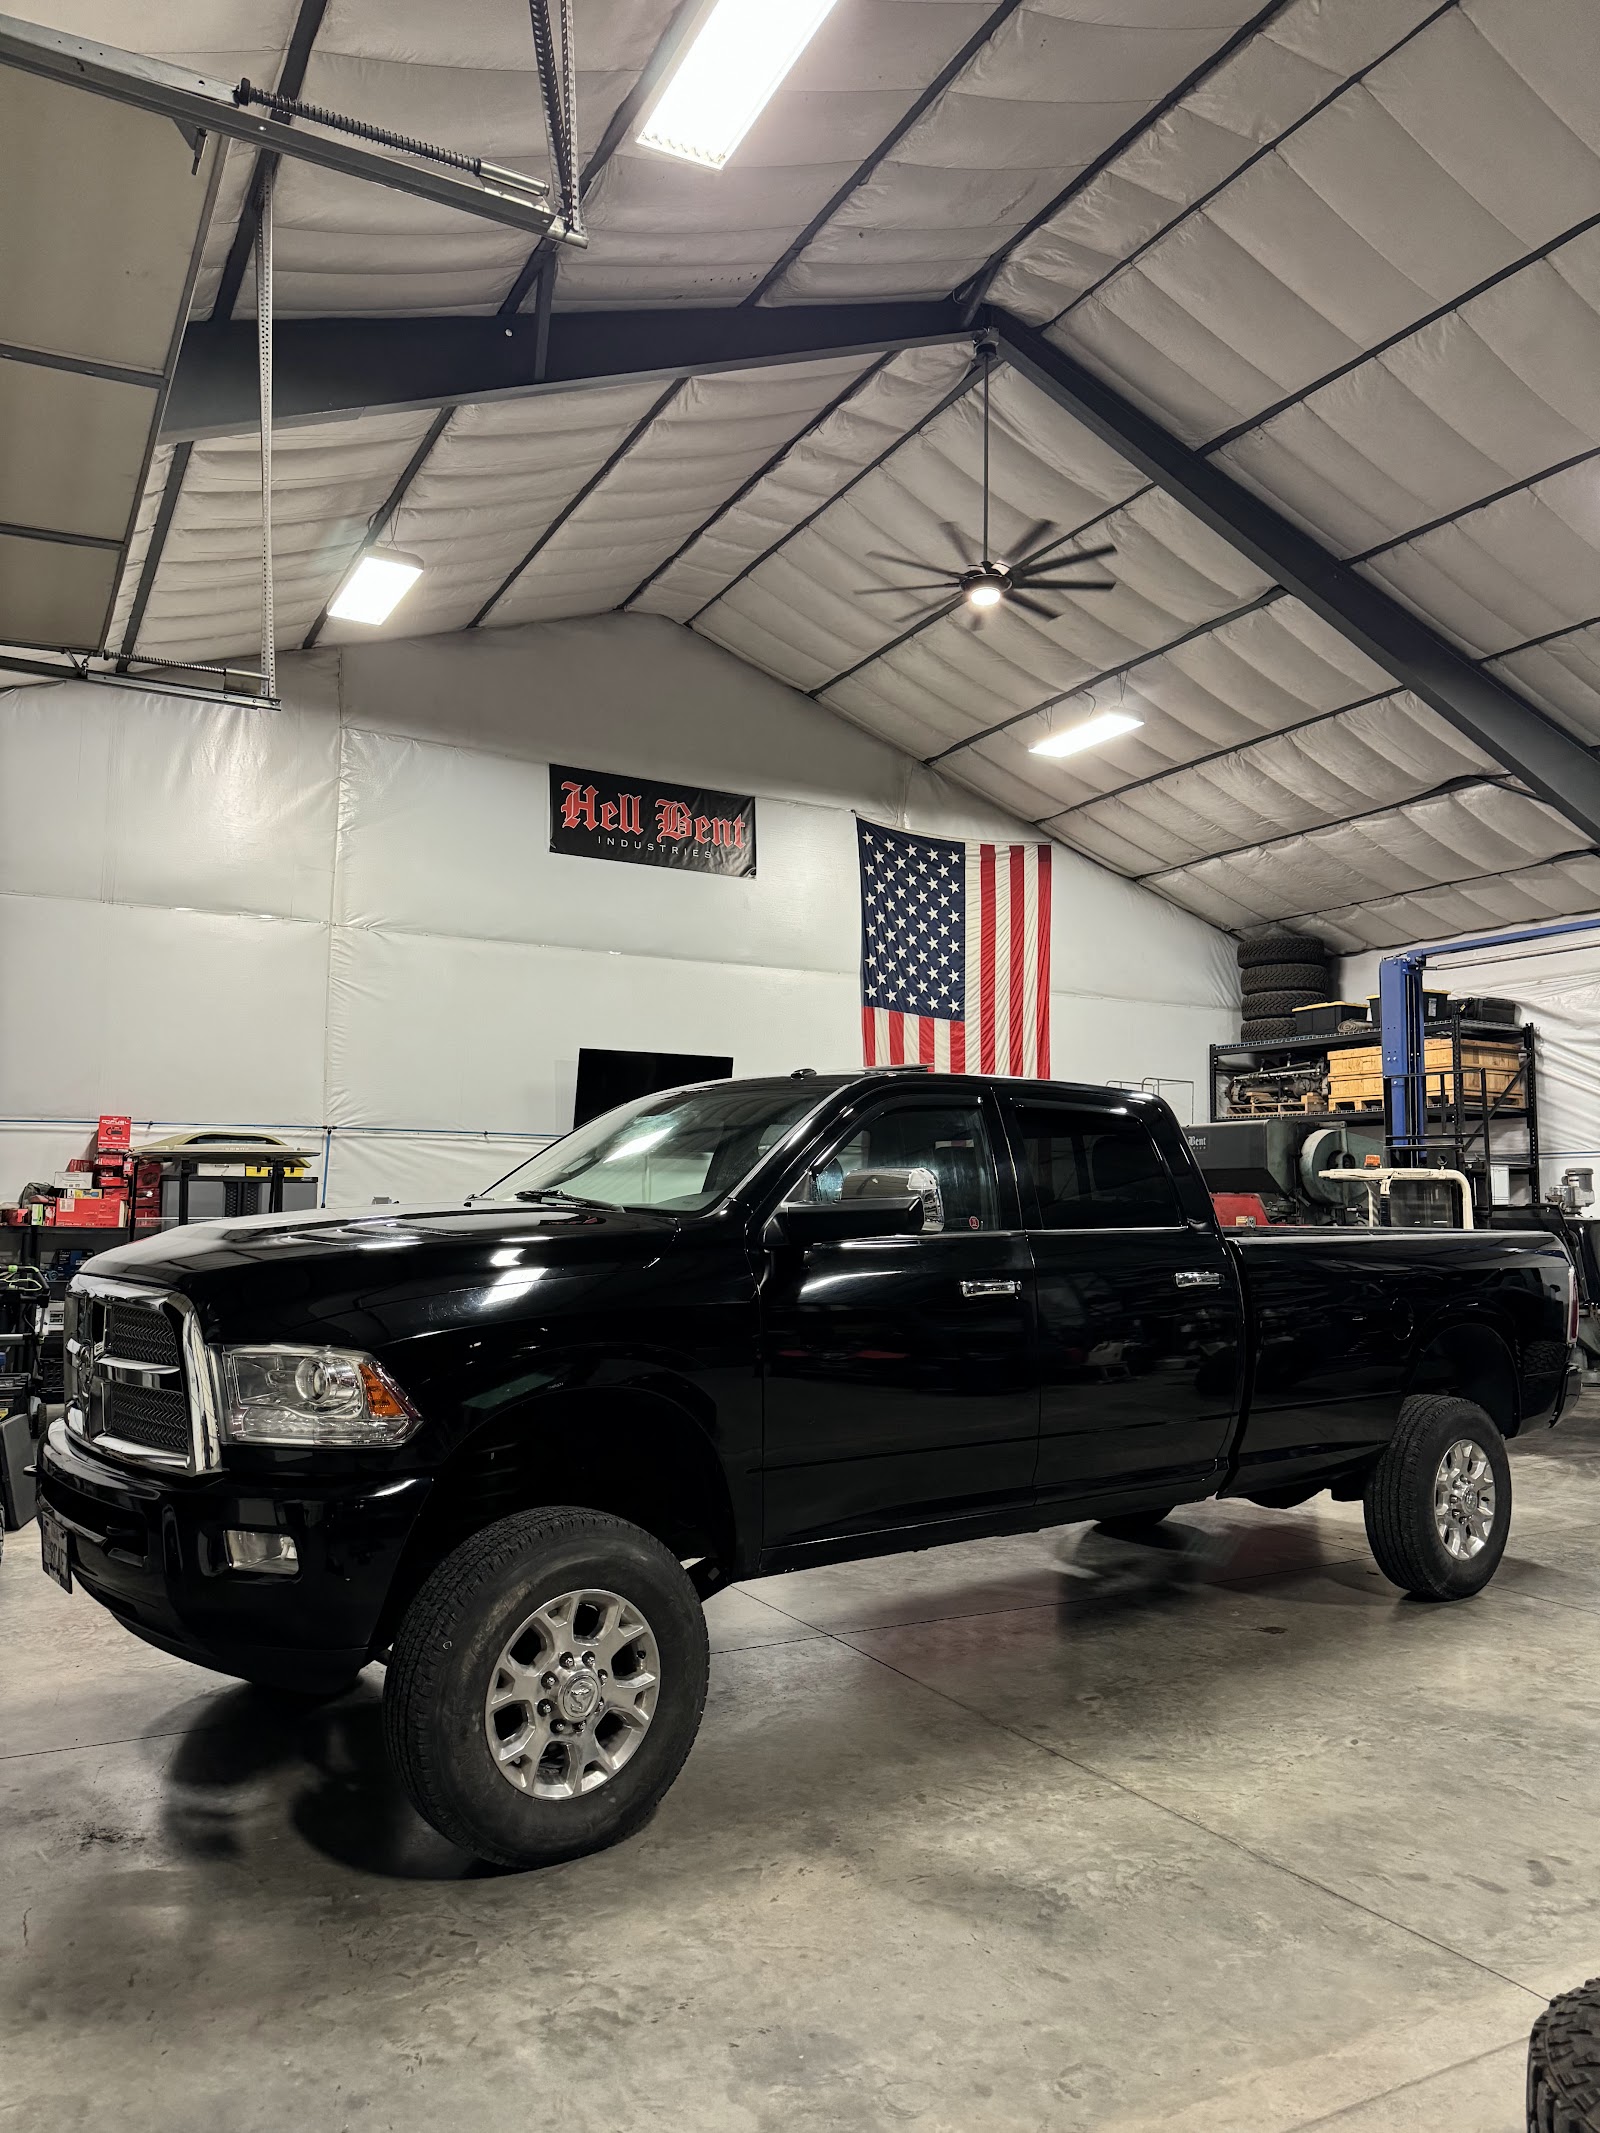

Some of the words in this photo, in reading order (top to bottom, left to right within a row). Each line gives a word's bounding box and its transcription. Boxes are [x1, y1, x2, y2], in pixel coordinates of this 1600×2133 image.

[561, 781, 644, 835] Hell
[655, 798, 746, 850] Bent
[598, 836, 712, 858] INDUSTRIES
[1188, 1136, 1206, 1146] Bent
